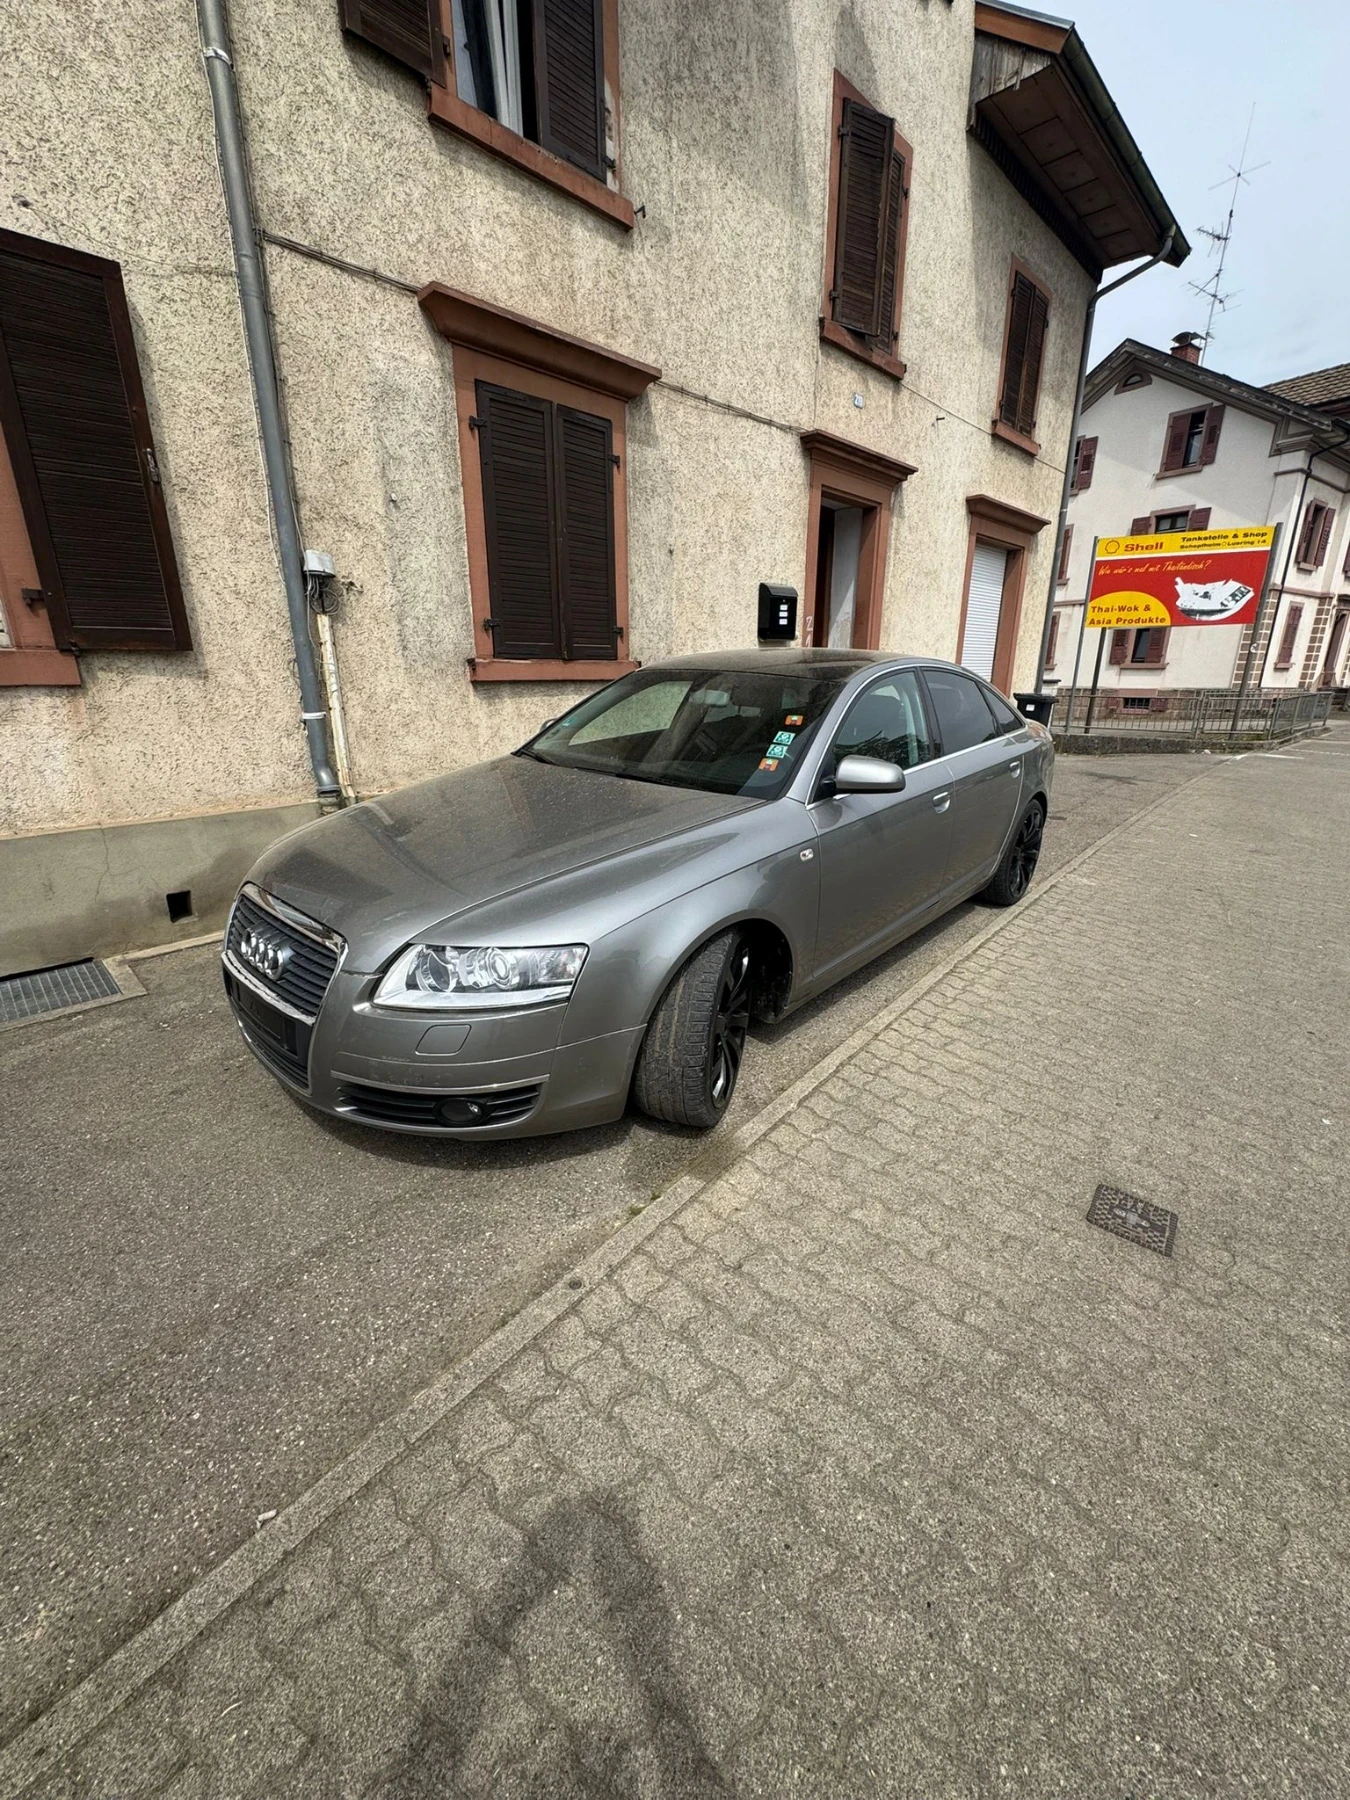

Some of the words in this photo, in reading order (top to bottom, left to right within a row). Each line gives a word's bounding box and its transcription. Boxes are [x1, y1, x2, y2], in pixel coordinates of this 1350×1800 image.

[1242, 531, 1268, 539] Shop
[1124, 541, 1164, 552] Shell
[1091, 605, 1139, 613] Thai-Wok
[1143, 604, 1151, 612] &
[1089, 618, 1112, 626] Asia
[1116, 616, 1166, 625] Produkte
